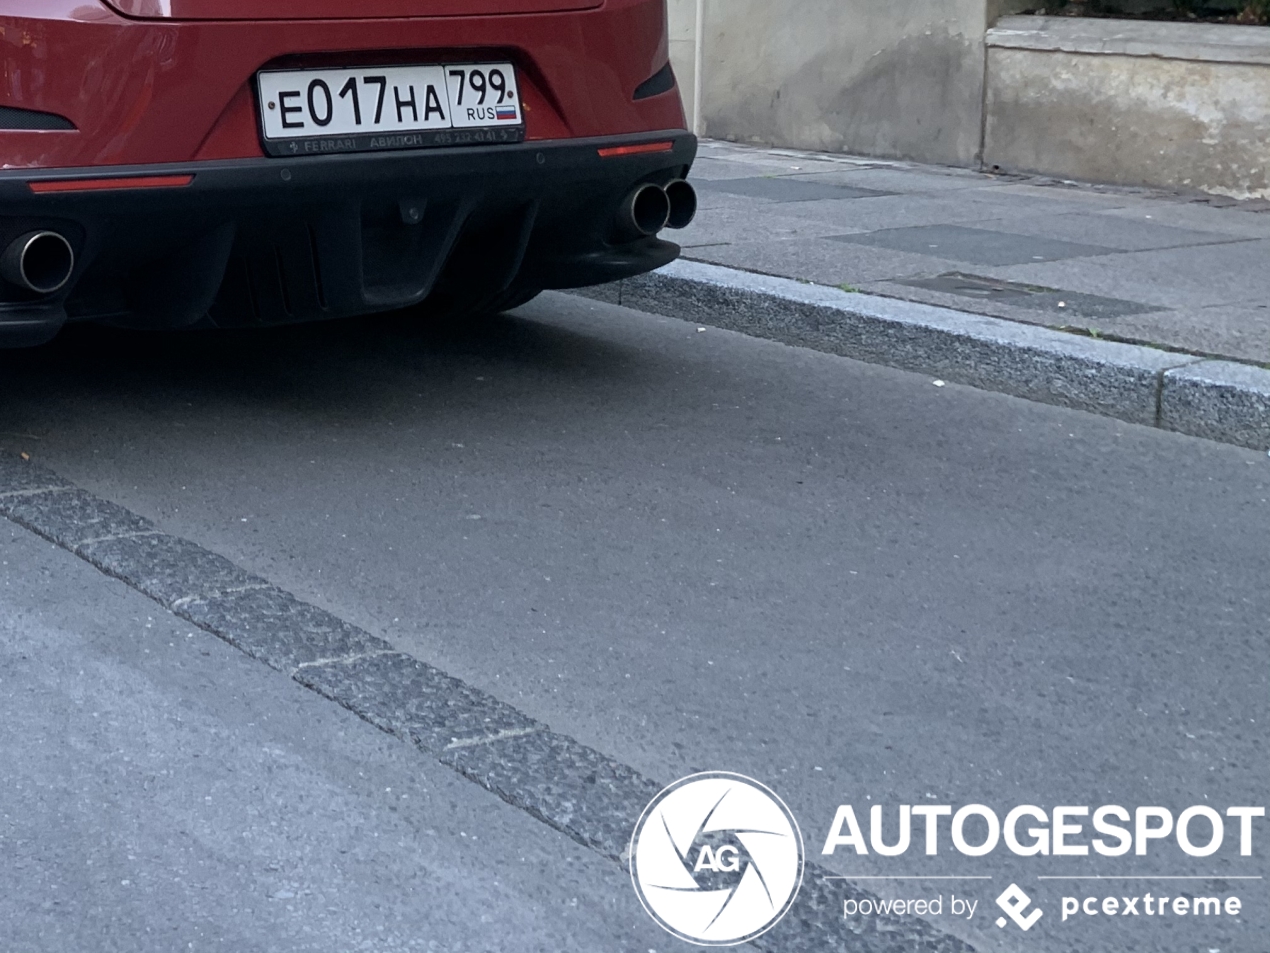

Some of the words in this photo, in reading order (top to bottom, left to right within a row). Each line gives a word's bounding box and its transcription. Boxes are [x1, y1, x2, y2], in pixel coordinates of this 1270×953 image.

[448, 69, 506, 106] 799
[467, 107, 496, 121] RUS
[304, 138, 356, 152] FERRARI
